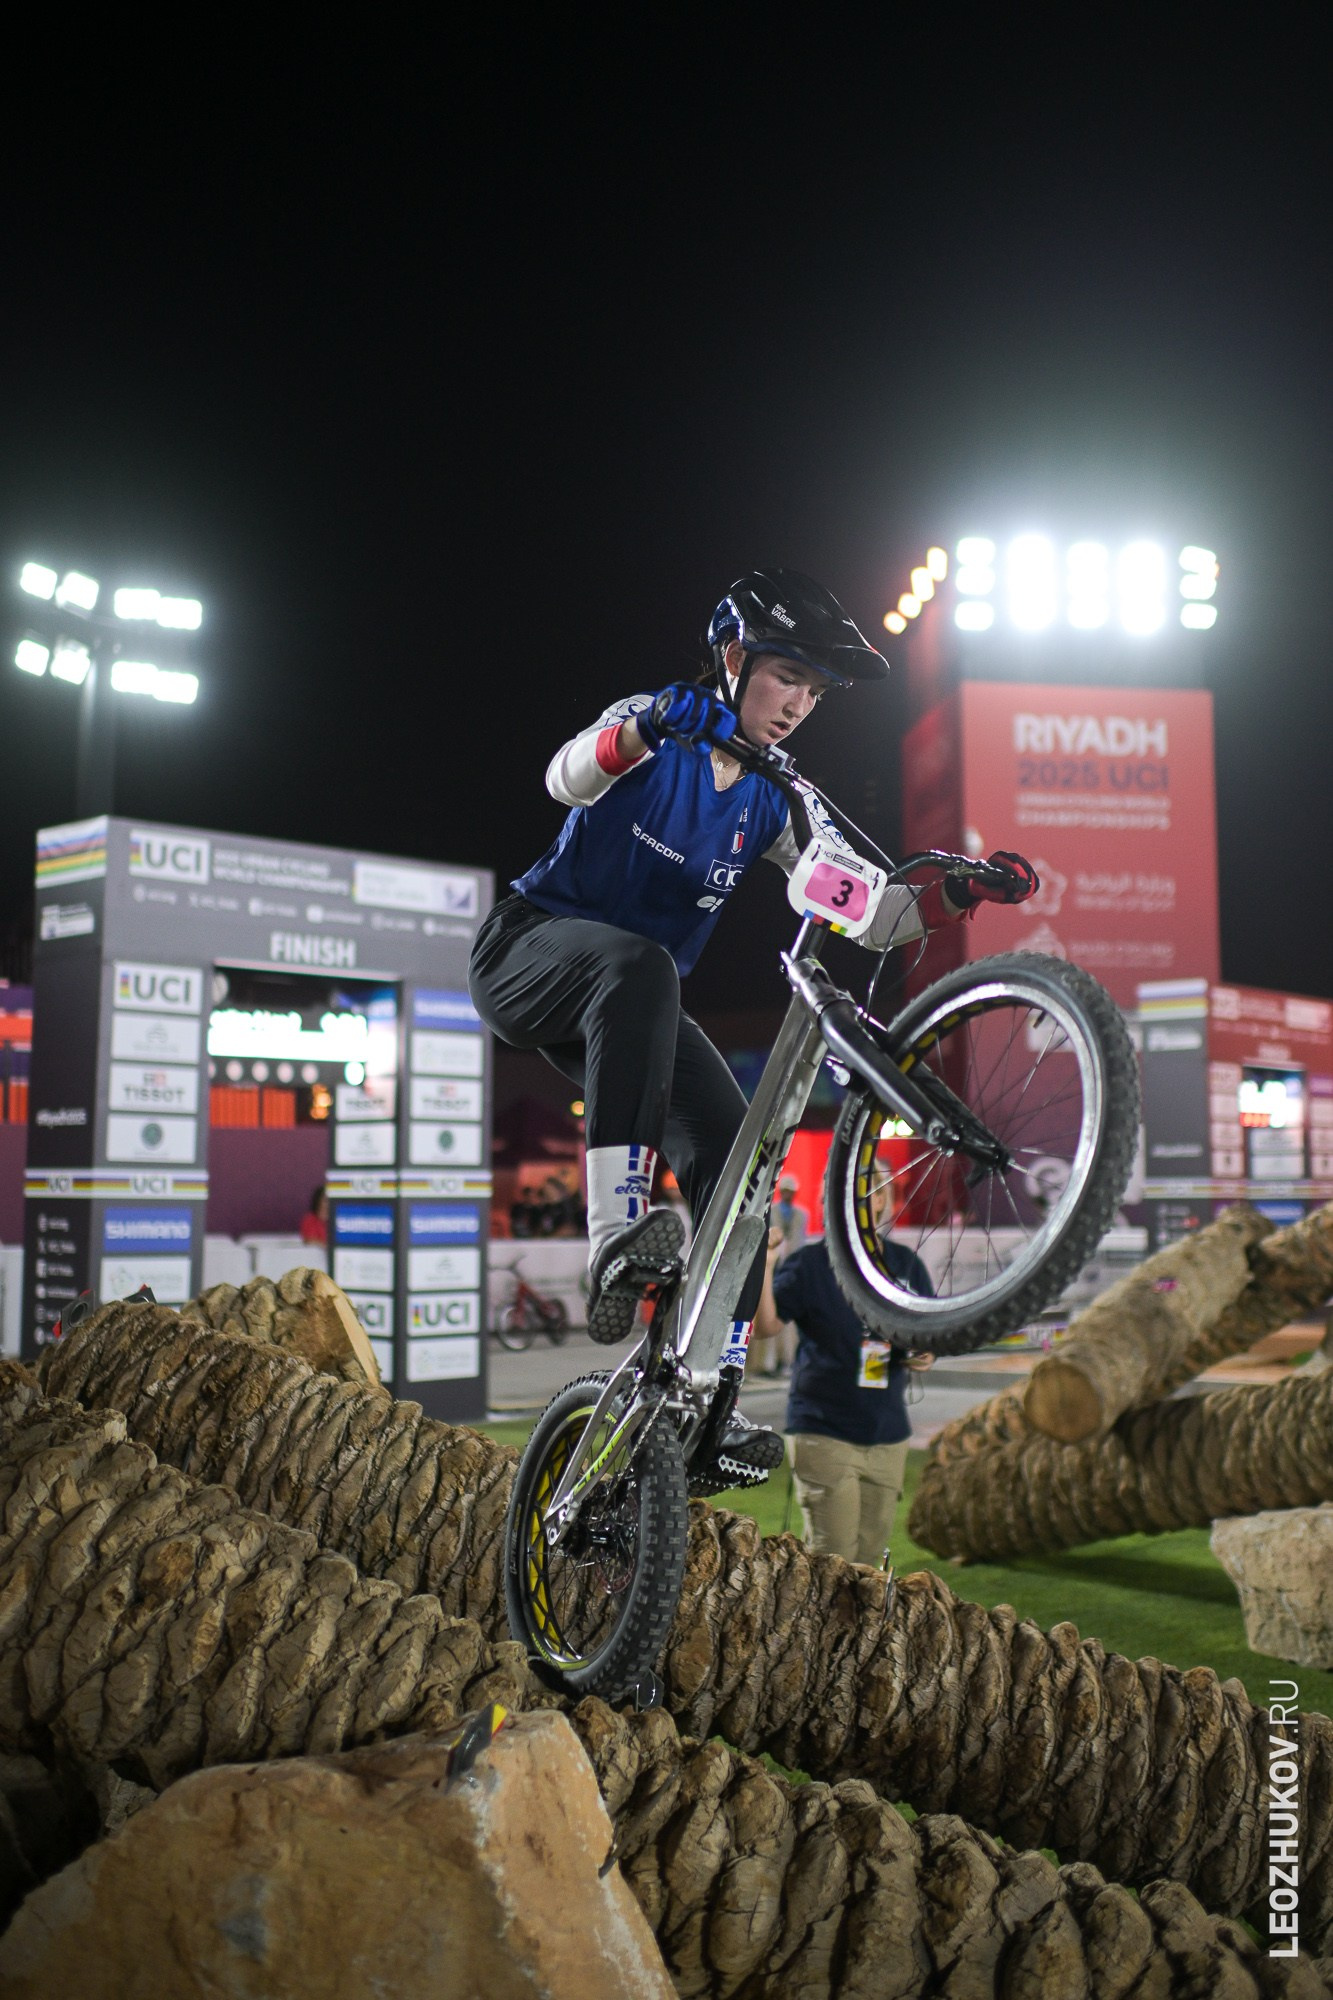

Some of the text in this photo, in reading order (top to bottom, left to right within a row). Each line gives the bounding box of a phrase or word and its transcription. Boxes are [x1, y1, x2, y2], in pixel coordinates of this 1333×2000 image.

[771, 607, 796, 629] VABRE
[1013, 713, 1169, 759] RIYADH
[1017, 759, 1170, 792] 2025 UCI
[144, 842, 202, 873] UCI
[640, 832, 685, 864] FACOM
[831, 879, 854, 908] 3
[270, 931, 357, 967] FINISH
[134, 973, 191, 1005] UCI
[124, 1085, 186, 1104] TISSOT
[132, 1176, 168, 1194] UCI
[104, 1220, 191, 1240] SHIMANO
[423, 1302, 470, 1327] UCI
